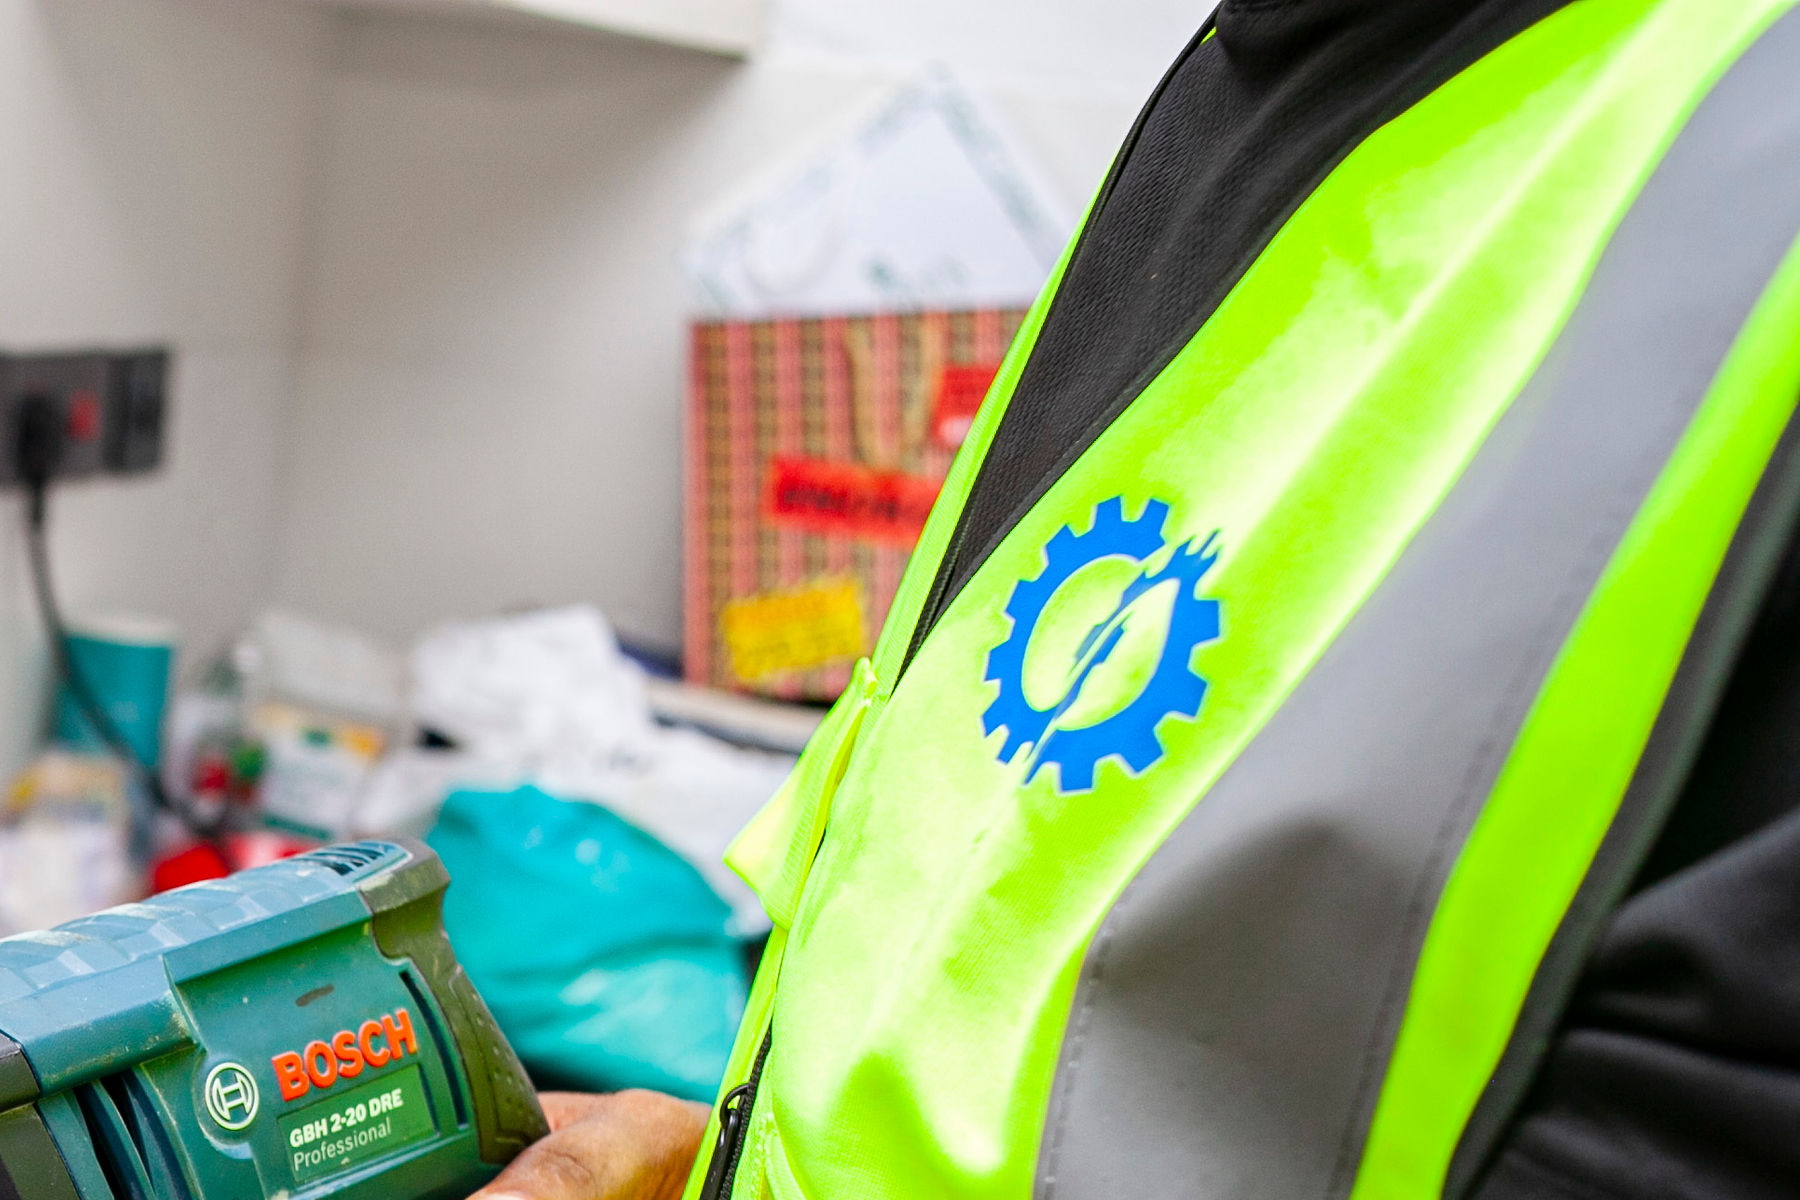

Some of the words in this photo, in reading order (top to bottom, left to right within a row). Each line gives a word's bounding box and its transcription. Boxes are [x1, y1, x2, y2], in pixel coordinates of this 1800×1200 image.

[271, 1008, 418, 1102] BOSCH
[289, 1118, 328, 1148] GBH
[330, 1103, 367, 1133] 2-20
[368, 1088, 404, 1117] DRE
[293, 1116, 392, 1171] Professional
